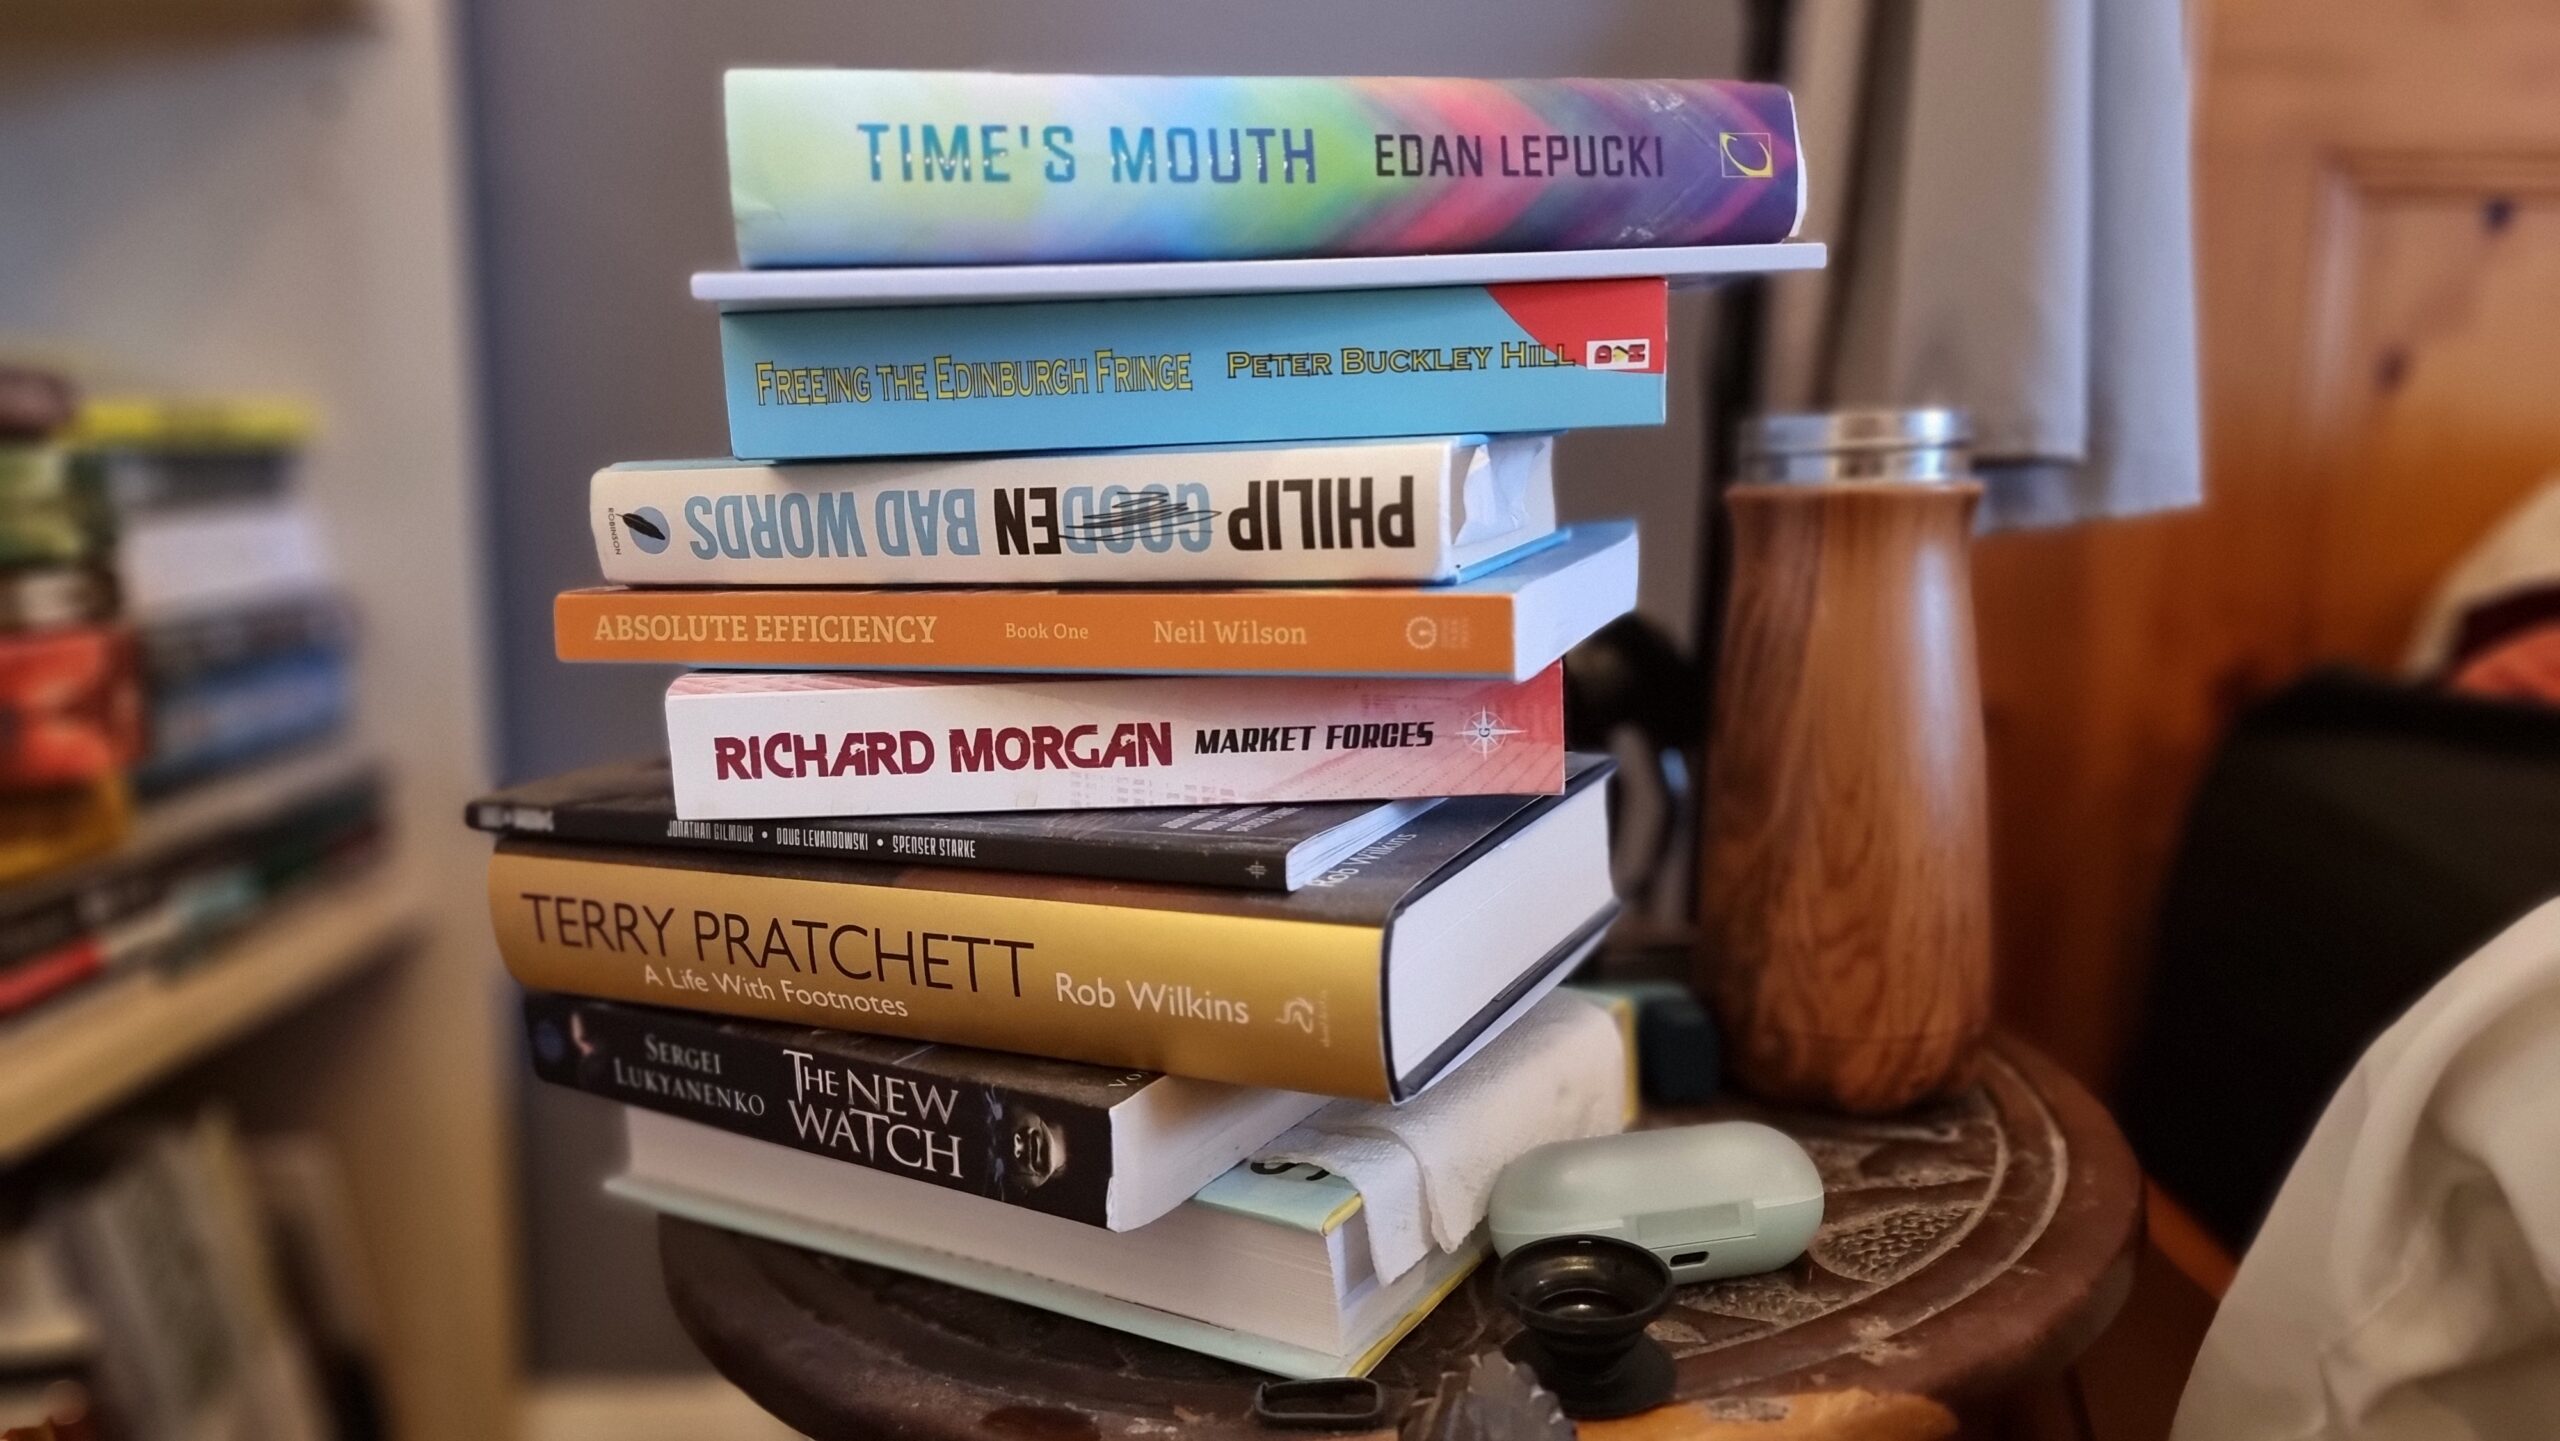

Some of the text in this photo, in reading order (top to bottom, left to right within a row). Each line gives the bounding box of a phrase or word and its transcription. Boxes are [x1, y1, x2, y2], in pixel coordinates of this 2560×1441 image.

[857, 123, 1317, 184] TIME'S MOUTH
[1375, 133, 1664, 177] EDAN LEPUCKI
[755, 348, 1193, 406] FREEING THE EDINBURGH FRINGE
[1226, 341, 1576, 379] PETER BUCKLEY HILL
[607, 506, 623, 556] ROBINSON
[684, 491, 868, 561] WORDS
[874, 488, 981, 558] BAD
[1227, 475, 1416, 551] PHILIP
[594, 614, 938, 644] ABSOLUTE EFFICIENCY
[1005, 622, 1089, 640] Book One
[1153, 620, 1308, 646] Neil Wilson
[713, 721, 1173, 781] RICHARD MORGAN
[1194, 720, 1435, 755] MARKET FORCES
[666, 820, 976, 859] JONATHAN GILMOUR DOUG LEVANDOWSKI SPENSER STARKE
[520, 893, 1035, 998] TERRY PRATCHETT
[643, 964, 910, 1018] A Life With Footnotes
[1055, 971, 1250, 1025] Rob Wilkins
[644, 1033, 721, 1076] SERGEI
[612, 1056, 766, 1117] LUKYANENKO
[846, 1068, 960, 1125] NEW
[787, 1099, 965, 1179] WATCH
